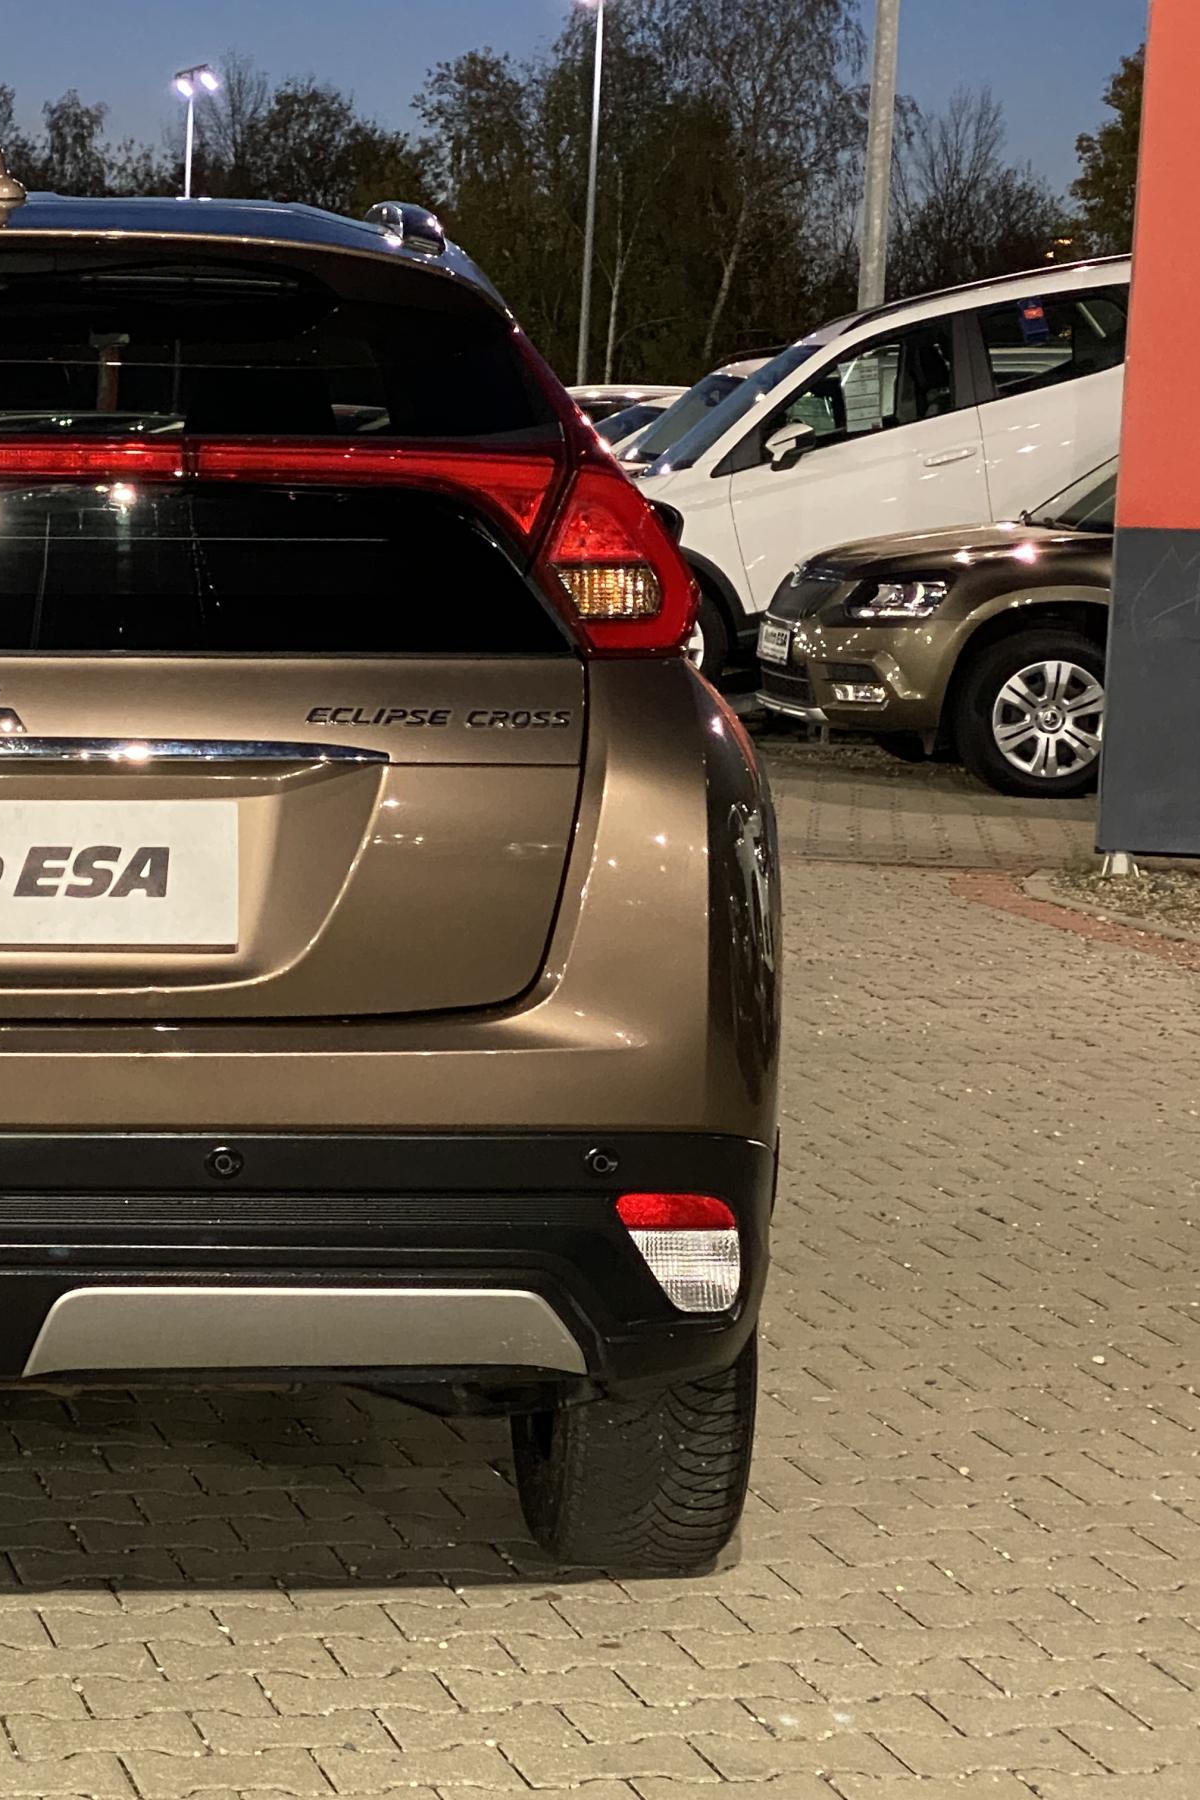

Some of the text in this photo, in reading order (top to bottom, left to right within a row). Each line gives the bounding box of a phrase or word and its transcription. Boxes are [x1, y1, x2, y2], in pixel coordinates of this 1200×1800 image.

[306, 707, 571, 728] ECLIPSE CROSS
[13, 846, 170, 898] ESA
